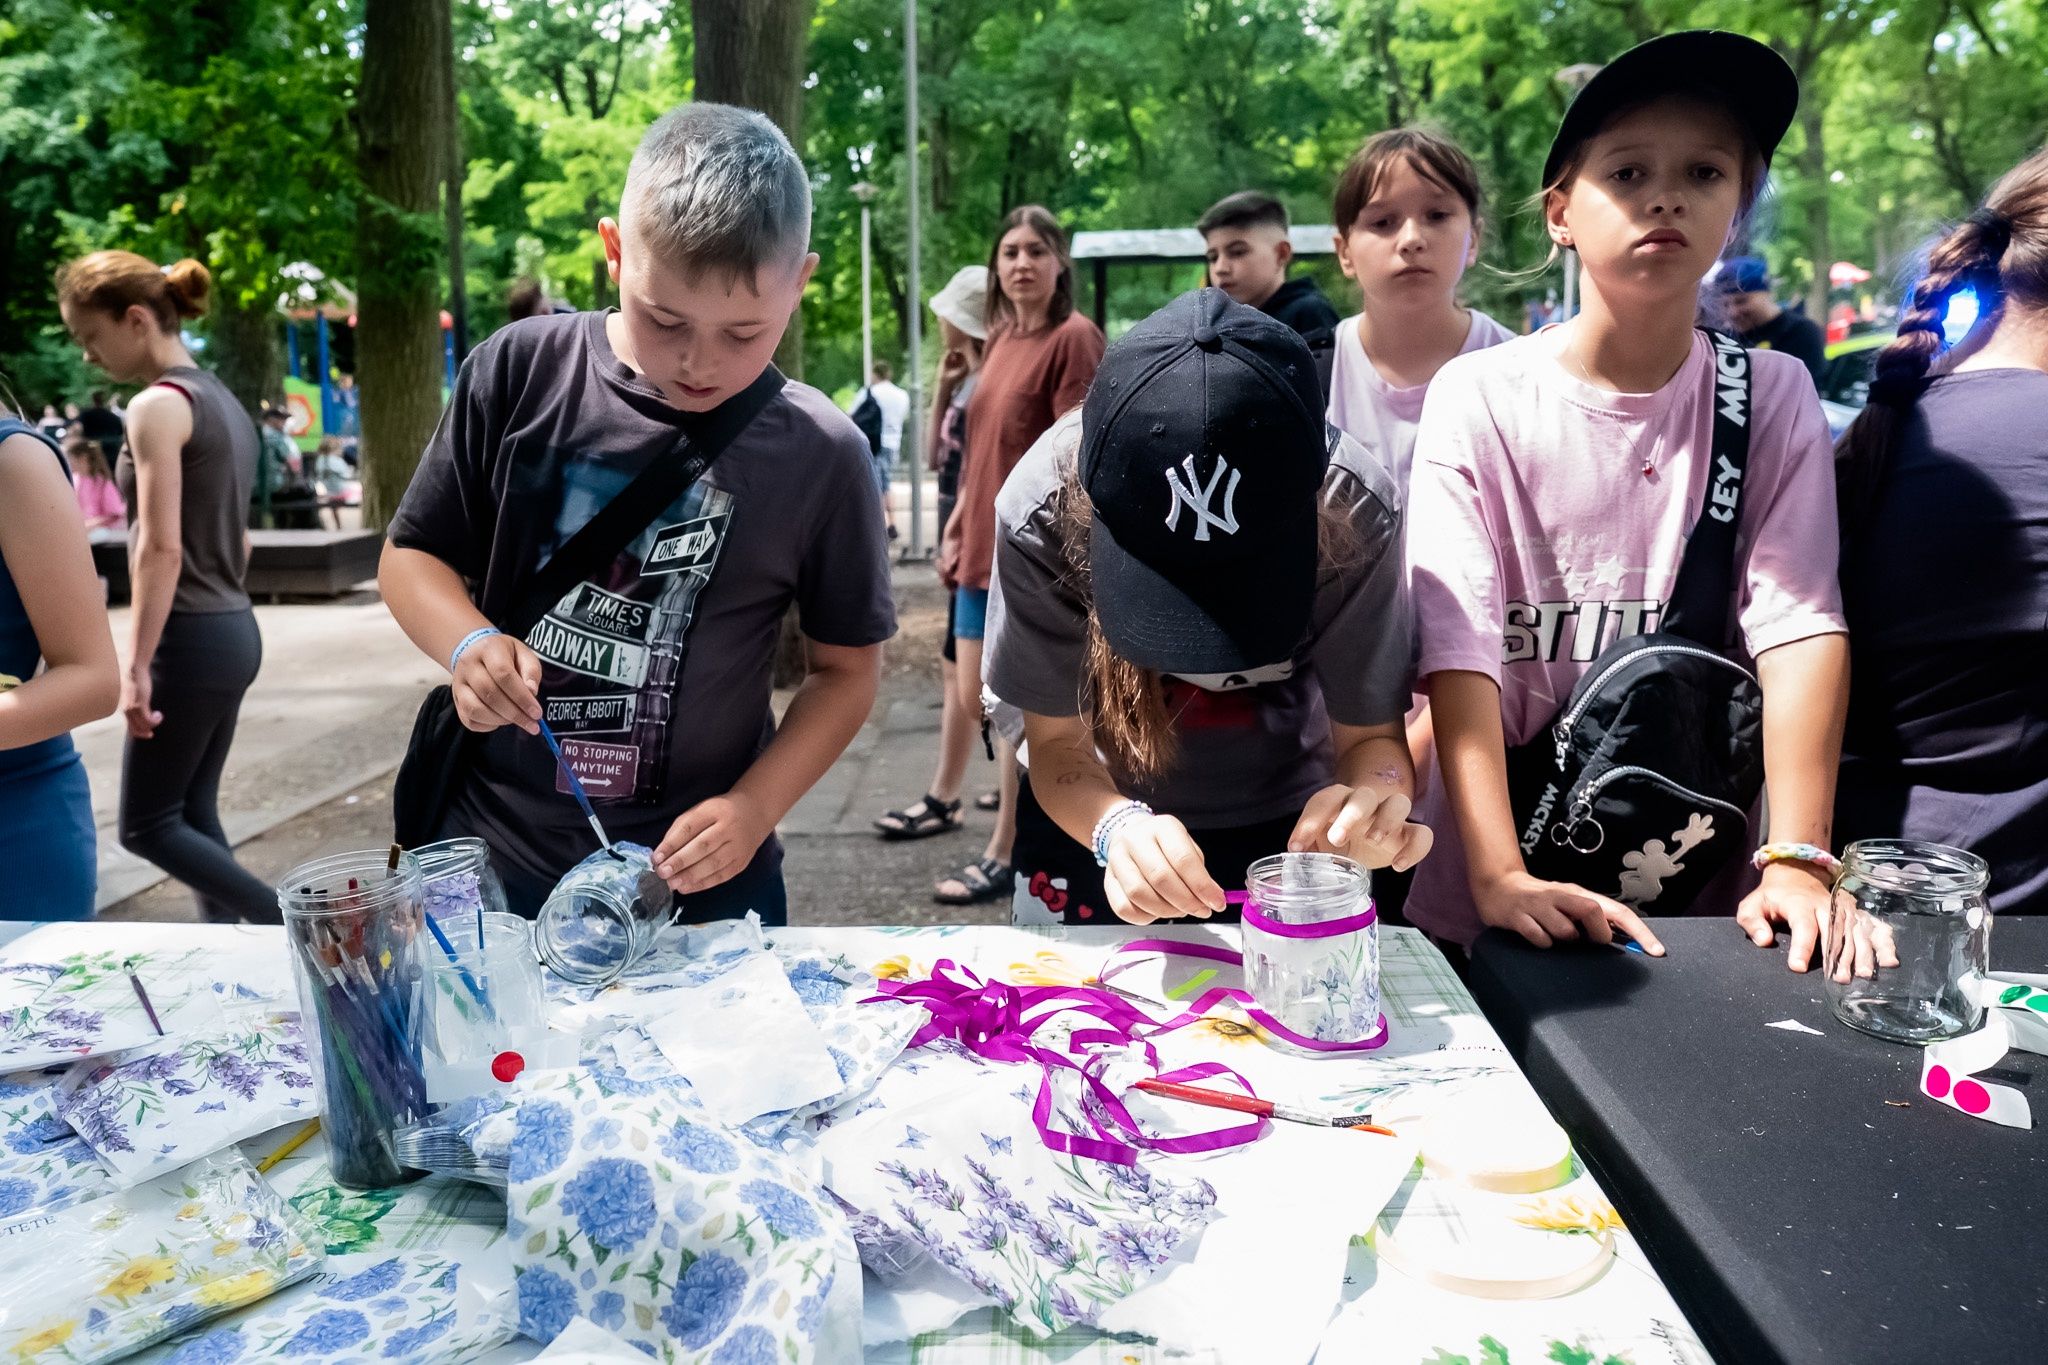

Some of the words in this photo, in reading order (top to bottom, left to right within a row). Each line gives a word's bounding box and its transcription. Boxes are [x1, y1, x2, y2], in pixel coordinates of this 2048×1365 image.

[1165, 453, 1242, 541] NY
[657, 538, 682, 560] ONE
[686, 531, 712, 554] WAY
[587, 591, 643, 627] TIMES
[586, 613, 630, 635] SQUARE
[546, 702, 583, 721] GEORGE
[585, 701, 623, 719] ABBOTT
[575, 720, 589, 729] WAY
[565, 745, 579, 756] NO
[583, 747, 633, 762] STOPPING
[571, 761, 622, 775] ANYTIME
[1520, 782, 1559, 855] MICKEY
